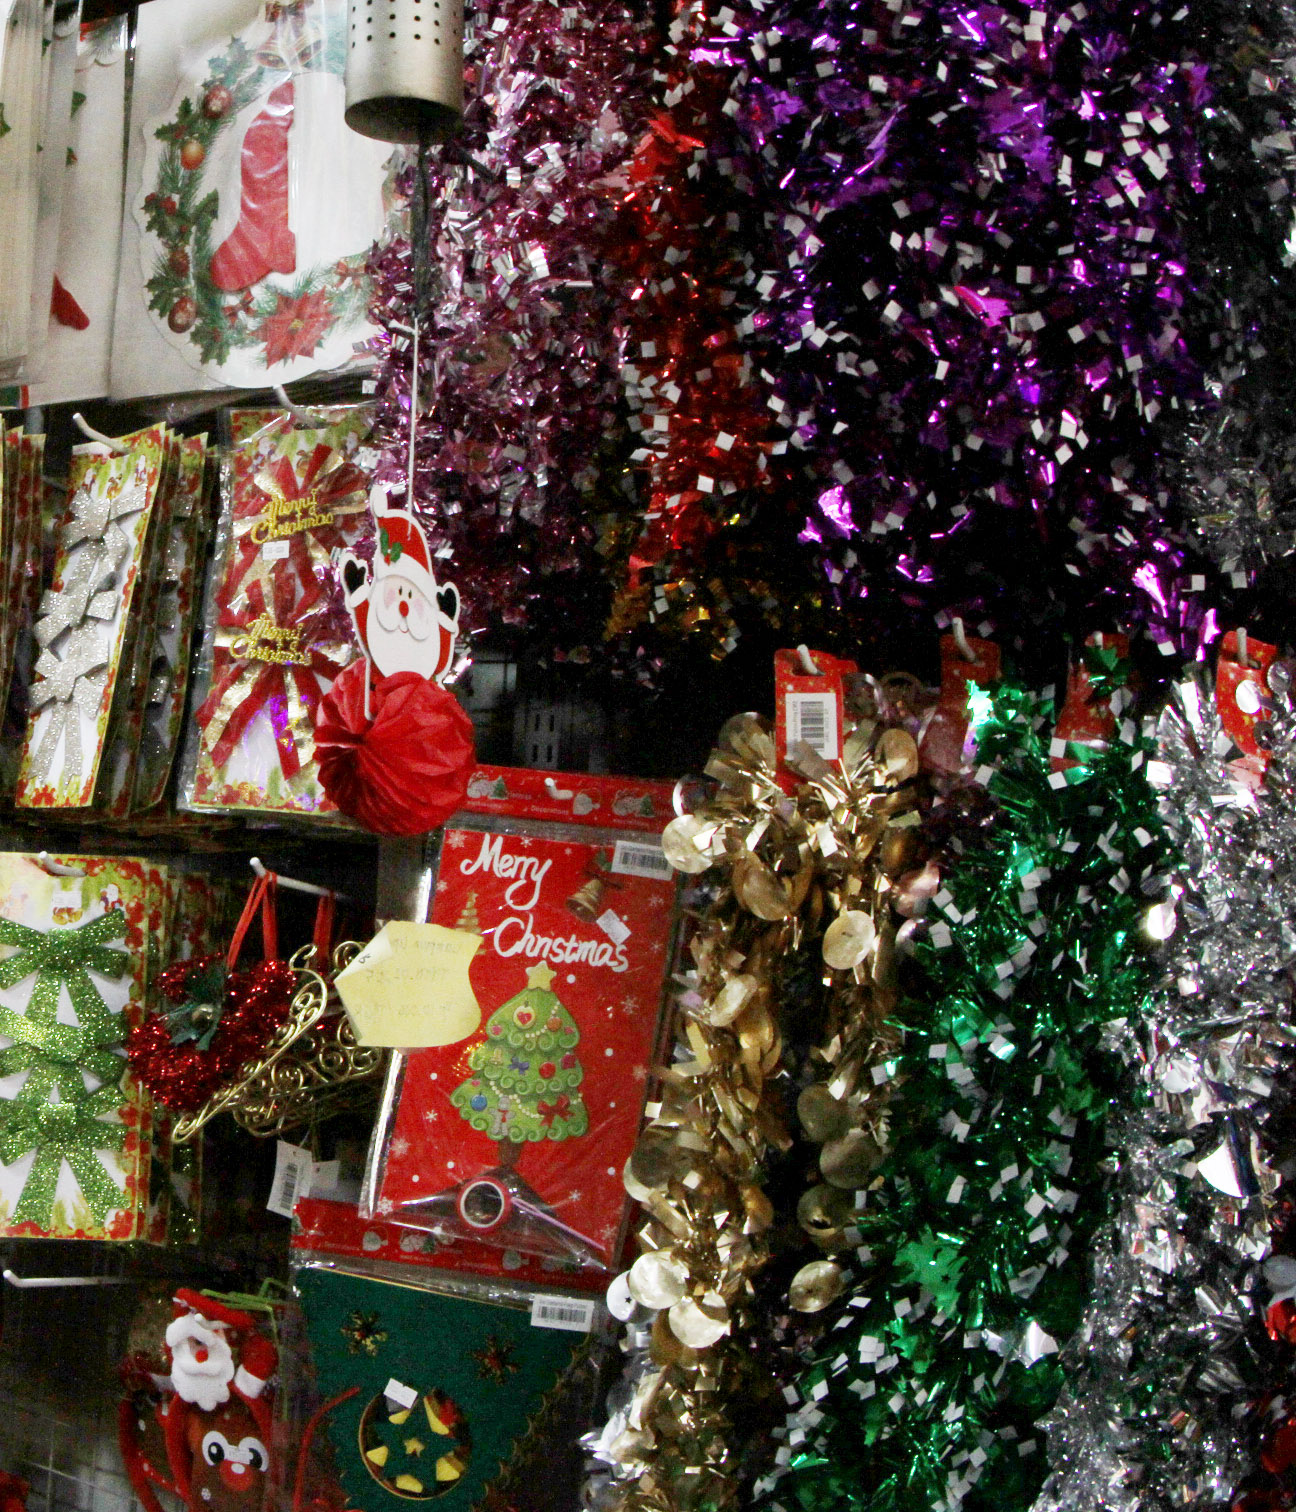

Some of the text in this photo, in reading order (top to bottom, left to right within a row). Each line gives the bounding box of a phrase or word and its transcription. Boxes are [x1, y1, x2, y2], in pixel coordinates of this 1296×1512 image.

[260, 488, 320, 516] Merry
[250, 512, 334, 545] Christmas
[245, 613, 305, 651] Merry
[229, 634, 313, 666] Christmas
[459, 832, 552, 911] Merry
[493, 913, 629, 973] Christmas
